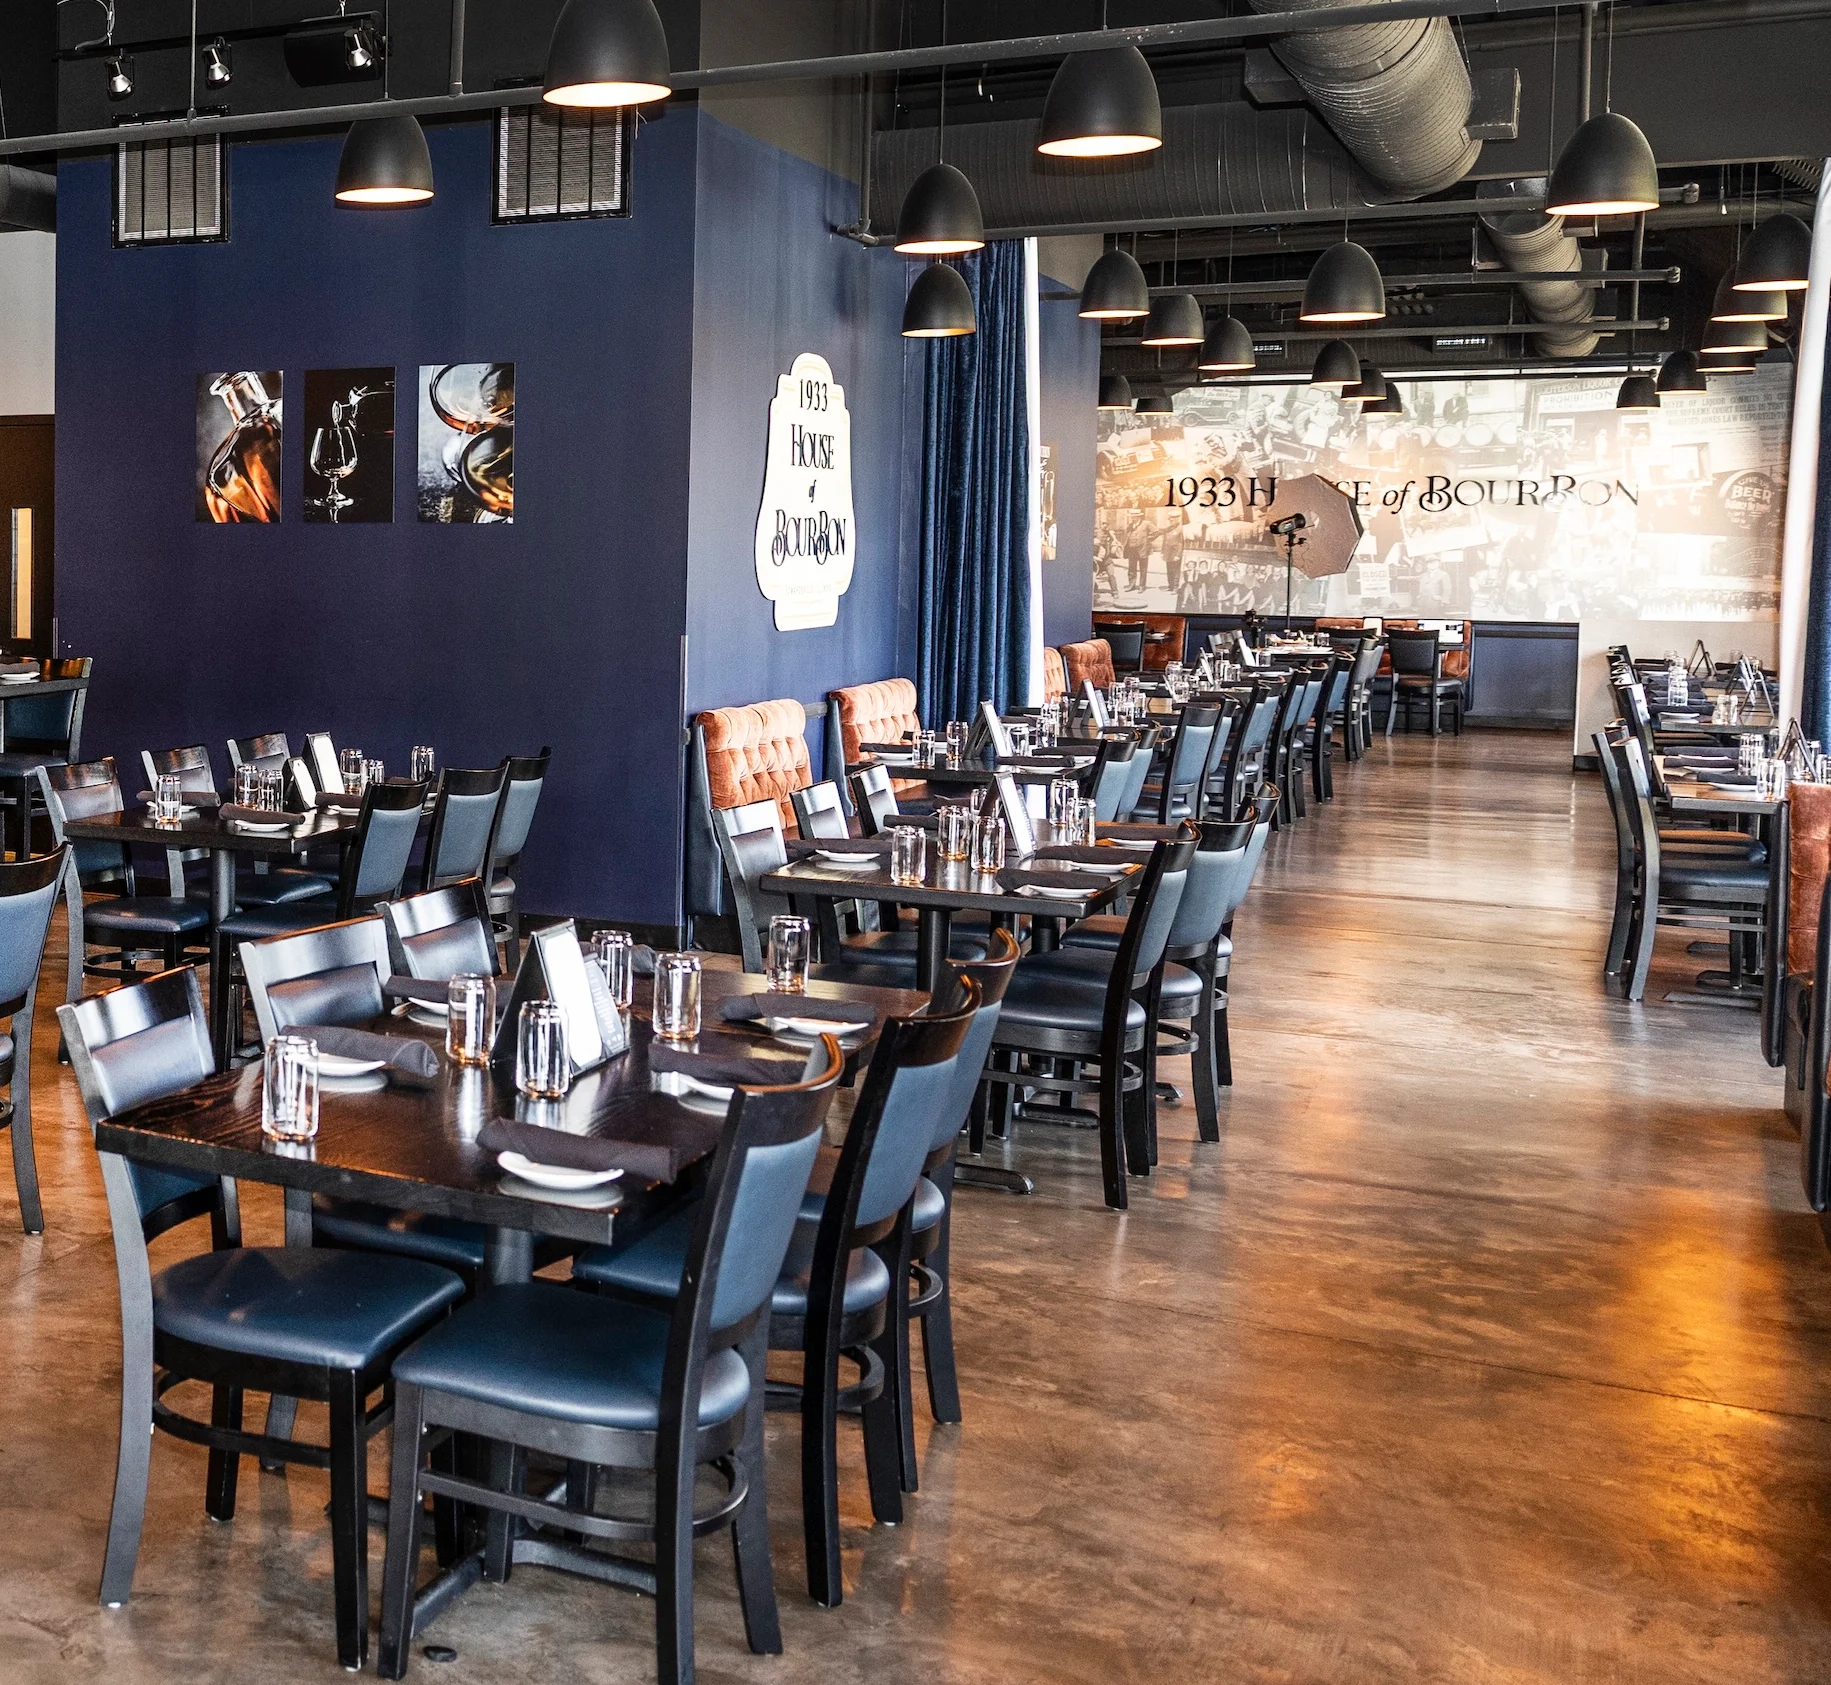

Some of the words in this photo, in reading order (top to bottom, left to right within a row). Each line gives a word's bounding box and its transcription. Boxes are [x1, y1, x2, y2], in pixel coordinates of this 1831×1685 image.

[799, 378, 828, 412] 1933
[1544, 390, 1613, 404] PROHIBITION
[1702, 398, 1726, 407] LIQUOR
[1722, 414, 1738, 423] LAW
[791, 423, 835, 470] HOUSE
[808, 479, 817, 503] of
[1165, 476, 1237, 507] 1933
[1246, 476, 1372, 507] HSE
[1382, 480, 1416, 515] of
[1731, 484, 1772, 504] BEER
